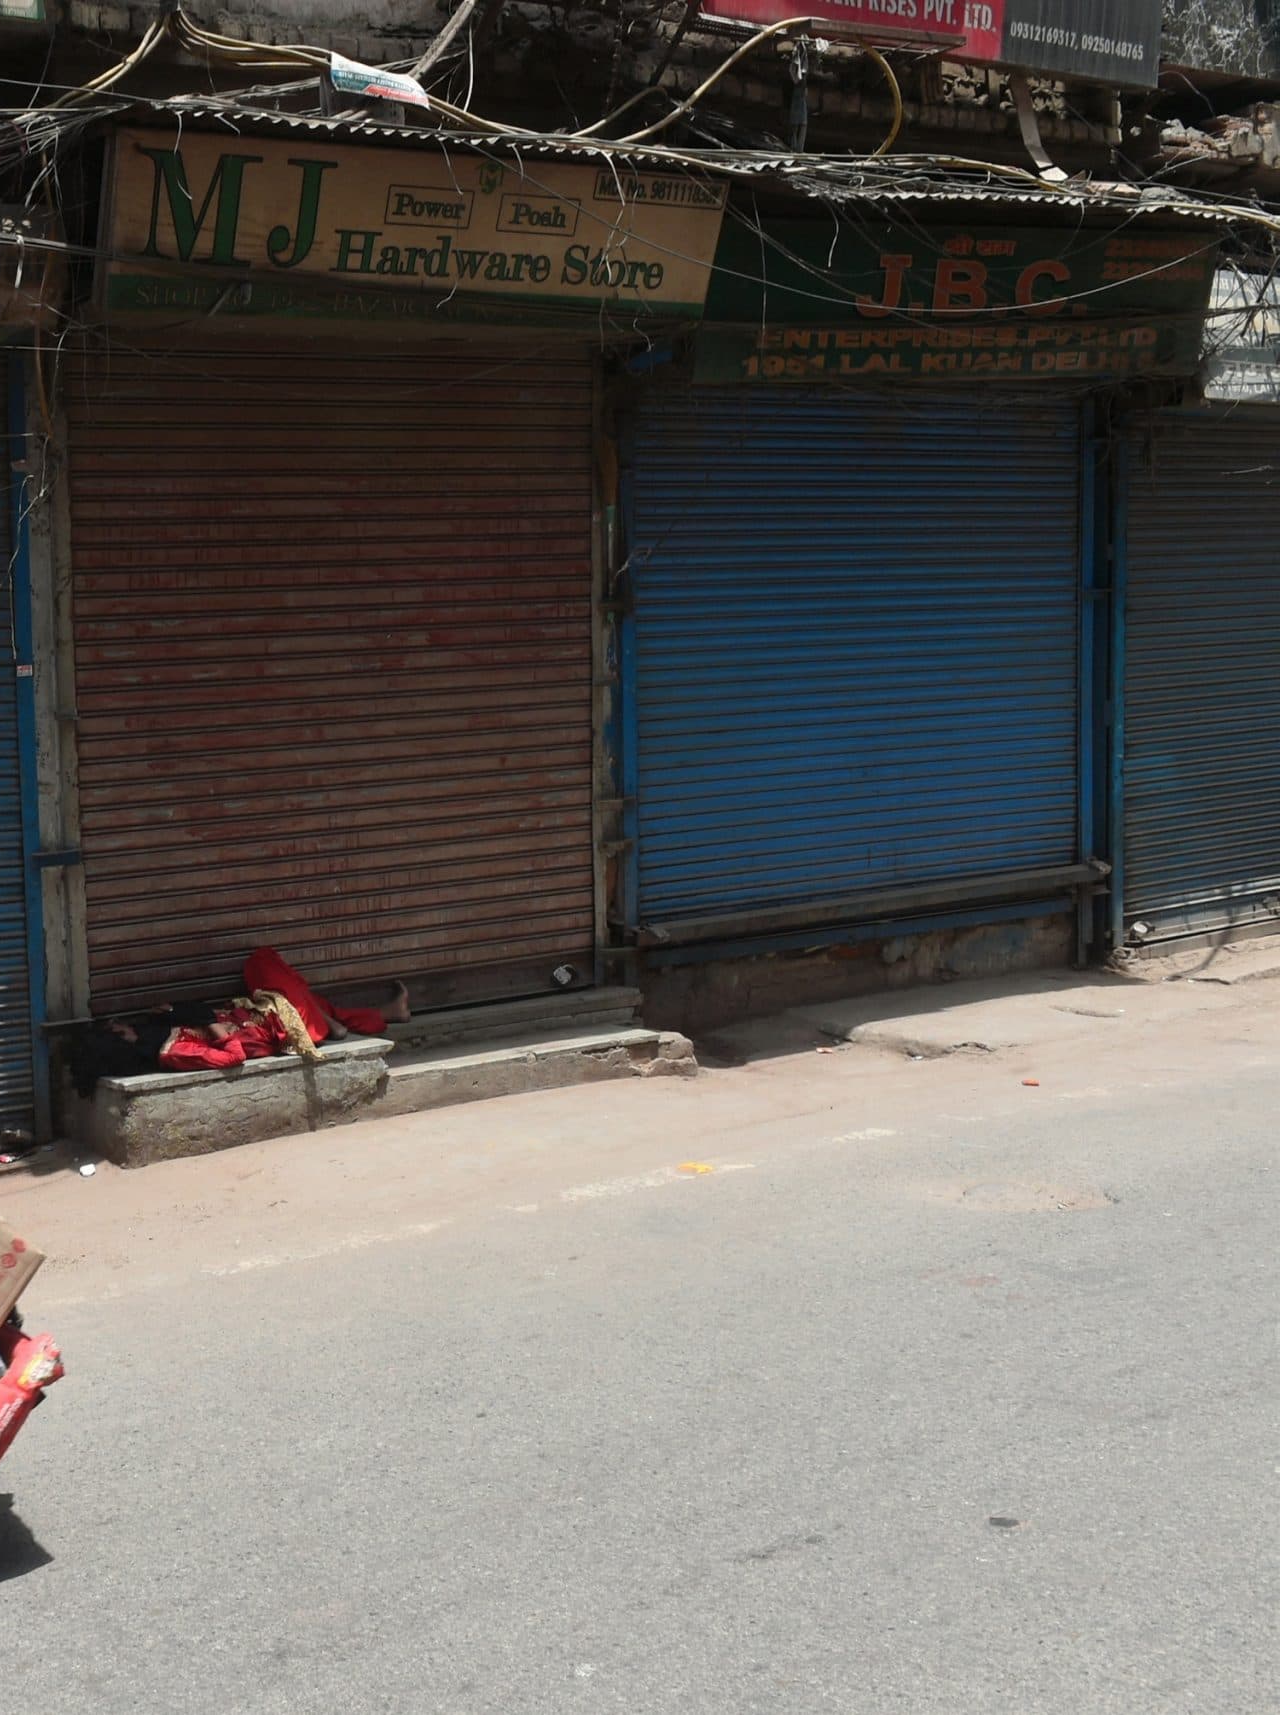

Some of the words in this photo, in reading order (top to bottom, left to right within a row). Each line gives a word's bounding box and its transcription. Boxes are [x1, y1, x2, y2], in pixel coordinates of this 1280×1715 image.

[963, 2, 997, 33] LTD.
[1009, 20, 1079, 51] 09312169317,
[1080, 33, 1144, 61] 09250148765
[391, 192, 465, 219] Power
[508, 202, 567, 228] Posh
[331, 228, 551, 283] Hardware
[560, 244, 665, 290] Store
[839, 352, 913, 374] LAL
